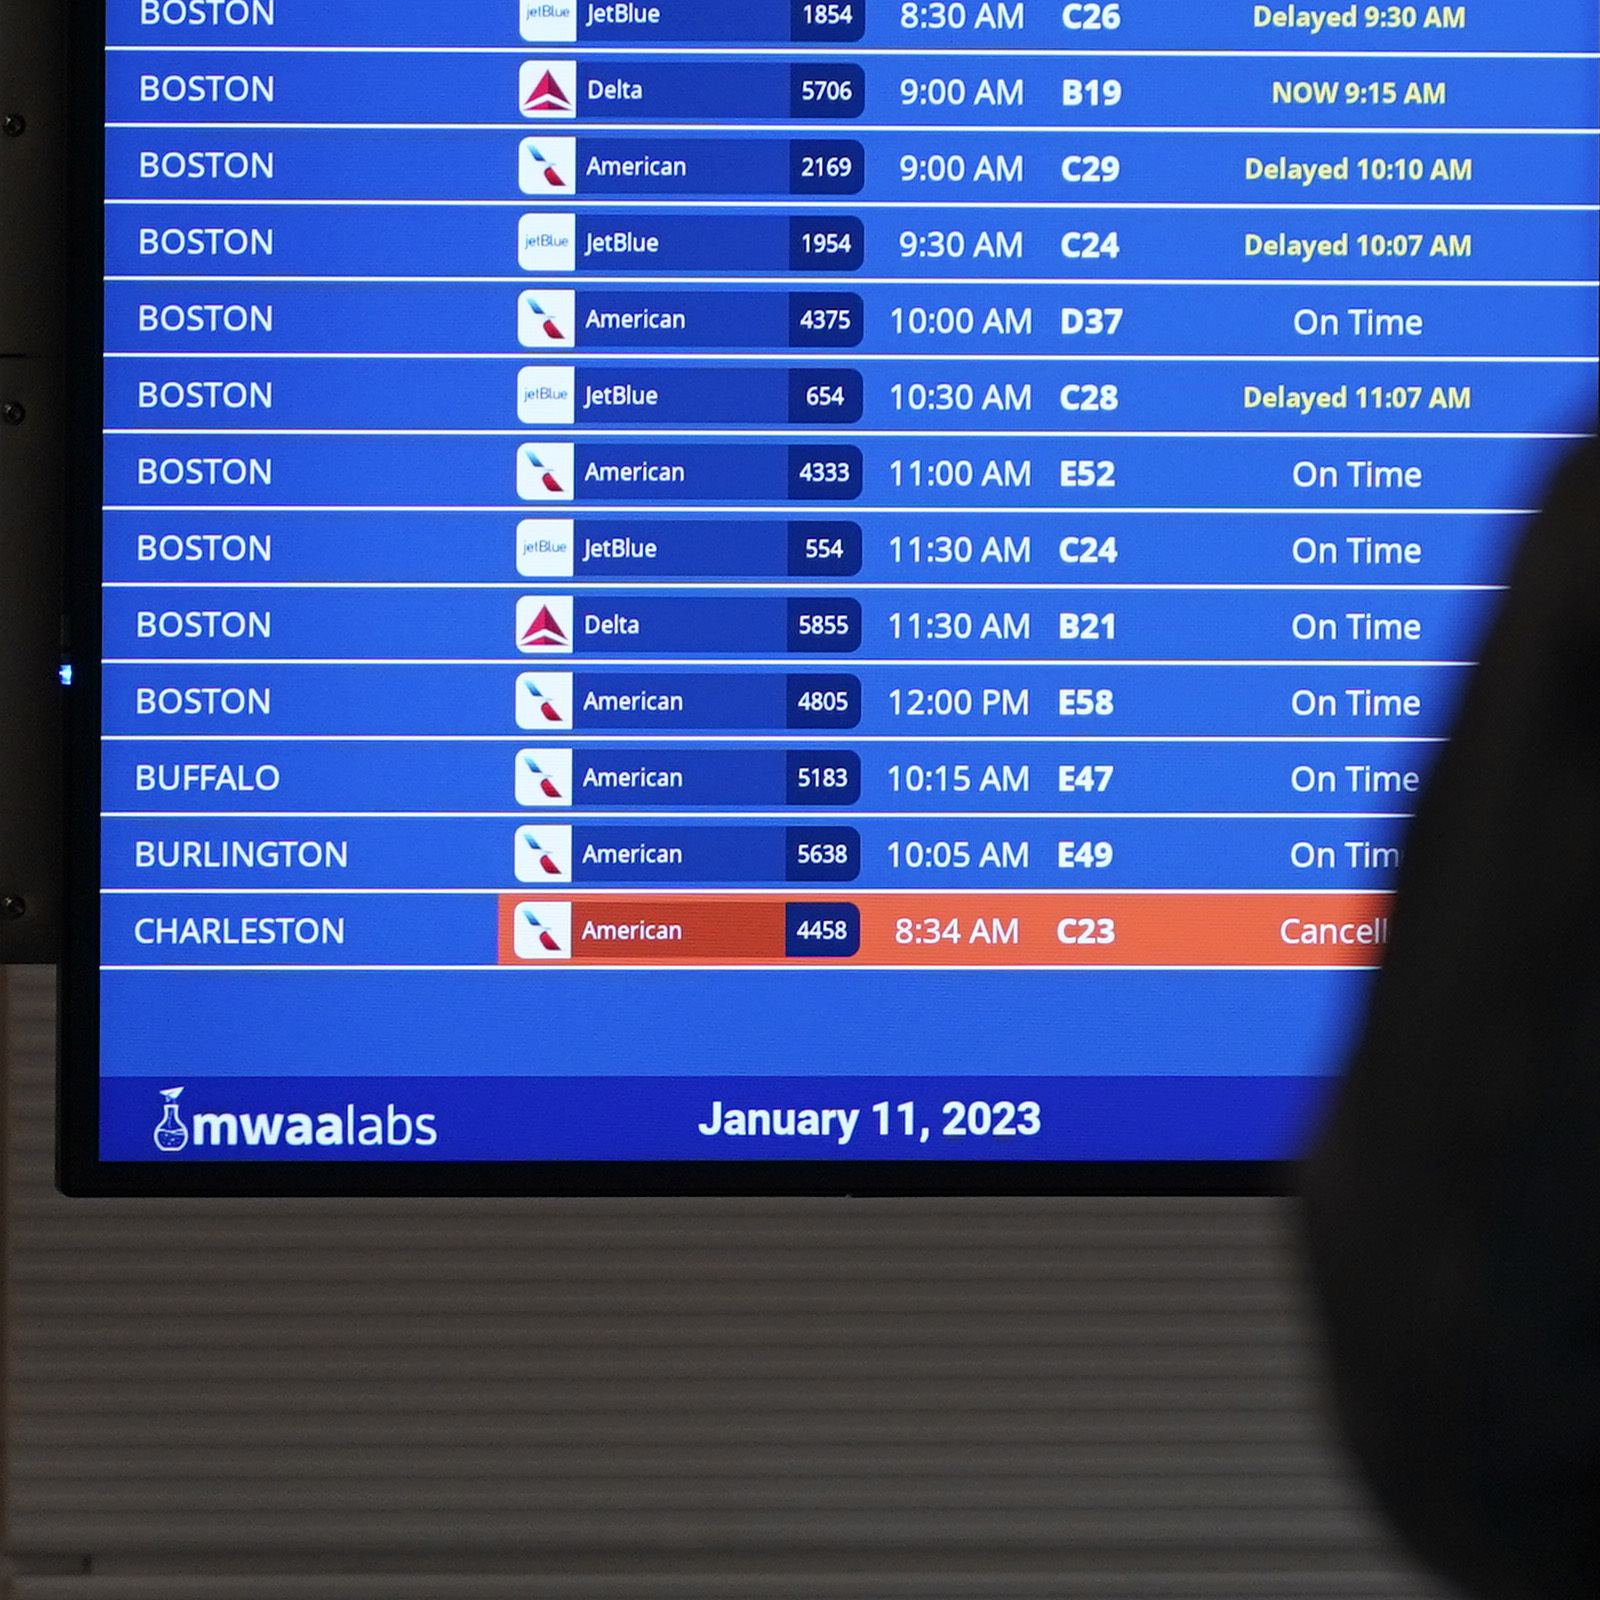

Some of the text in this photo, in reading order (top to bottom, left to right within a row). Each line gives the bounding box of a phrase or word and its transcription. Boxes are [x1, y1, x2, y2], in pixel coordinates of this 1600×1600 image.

[134, 917, 1388, 945] CHARLESTON American 4458 8:34 AM C23 Cancell
[192, 1103, 437, 1146] mwaalabs
[698, 1100, 1041, 1145] January 11, 2023
